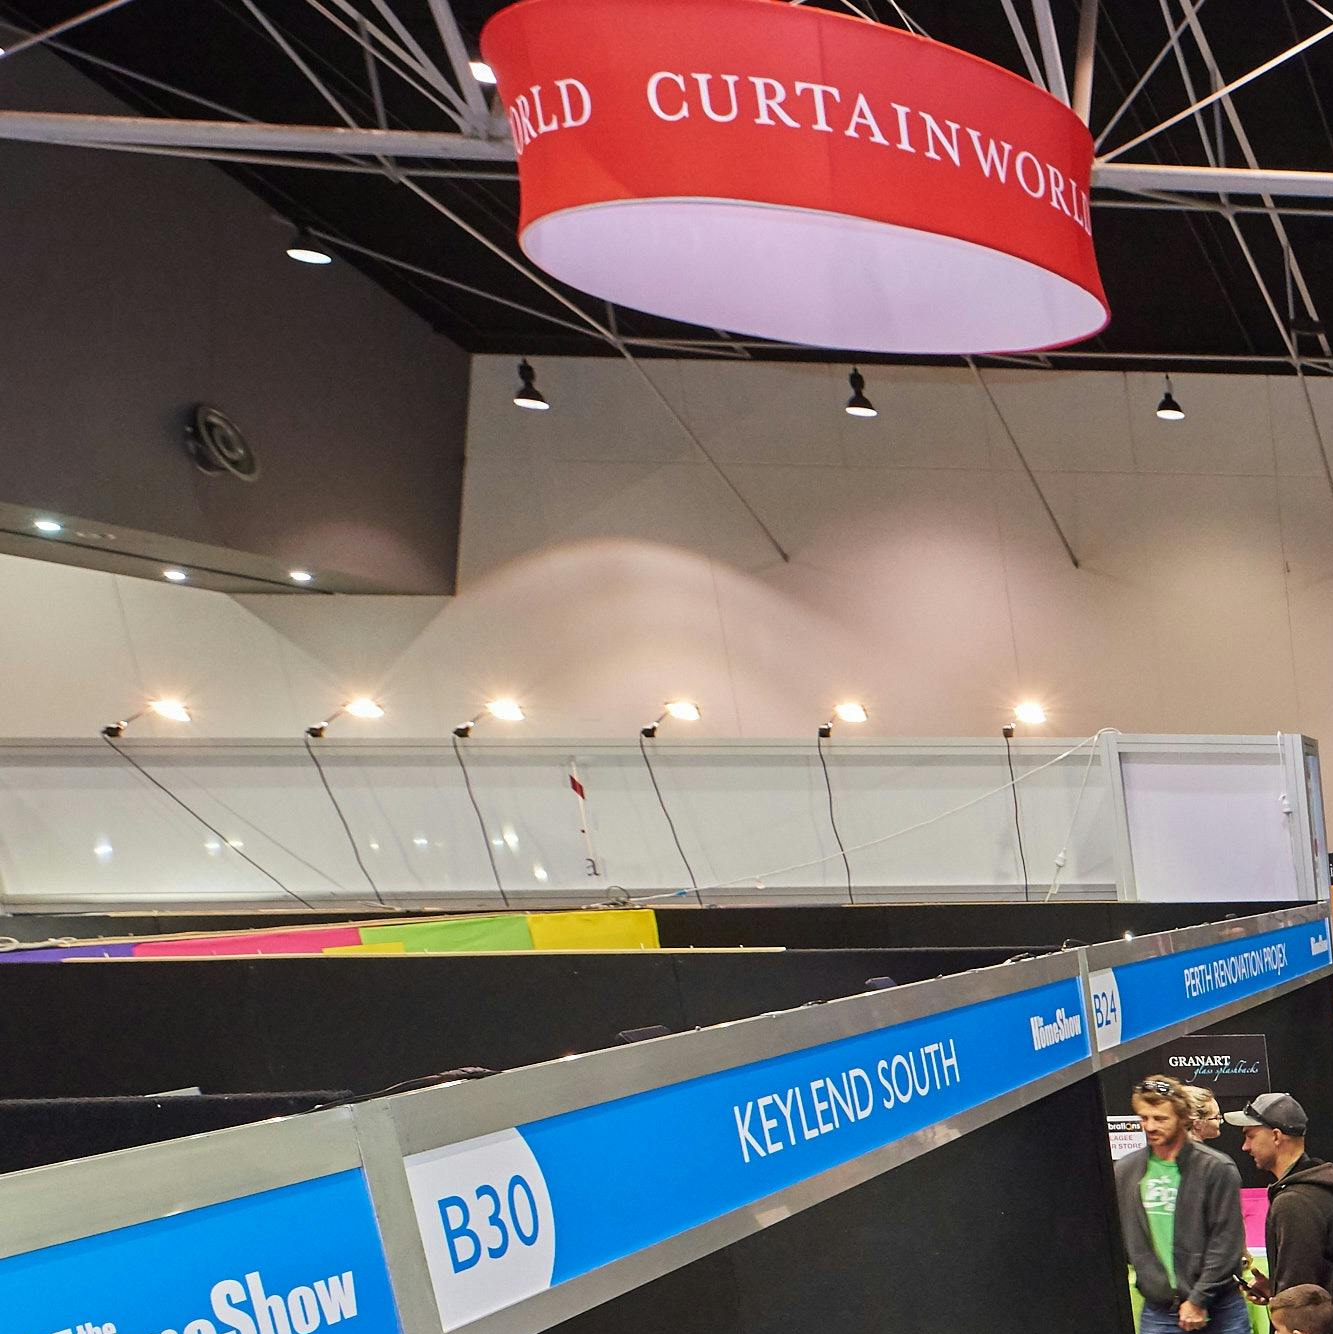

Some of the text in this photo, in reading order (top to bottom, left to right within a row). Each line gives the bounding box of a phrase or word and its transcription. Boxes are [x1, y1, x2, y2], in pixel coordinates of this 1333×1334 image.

[1093, 990, 1117, 1029] B24
[1183, 966, 1212, 998] PERTH
[1213, 950, 1262, 990] RENOVATION
[1263, 942, 1288, 977] PROJEX
[1030, 1008, 1082, 1051] HomeShow
[1168, 1055, 1231, 1067] GRANART
[1185, 1059, 1260, 1083] glass splashbacks
[437, 1039, 961, 1274] B30 KEYLEND SOUTH
